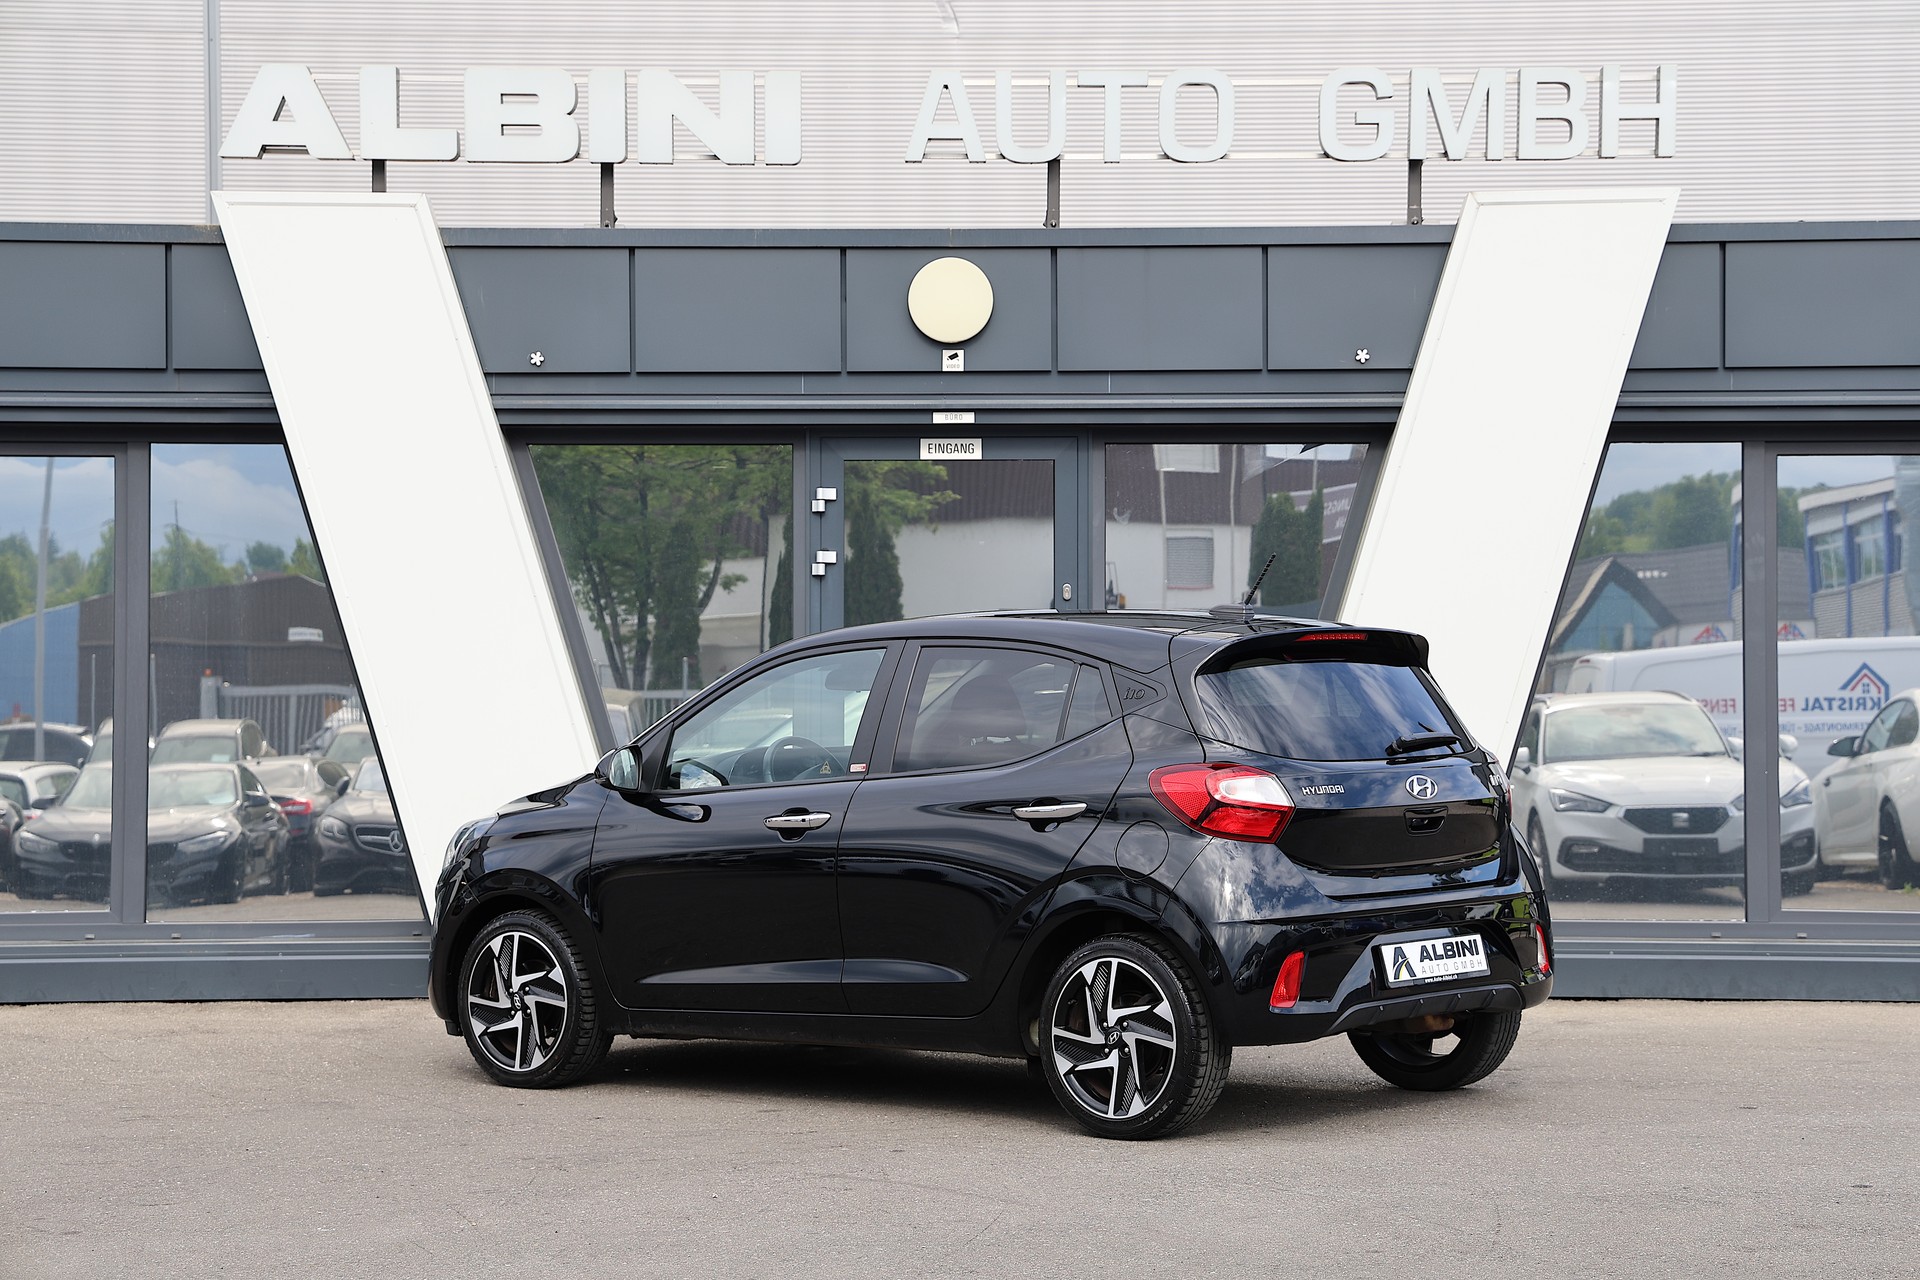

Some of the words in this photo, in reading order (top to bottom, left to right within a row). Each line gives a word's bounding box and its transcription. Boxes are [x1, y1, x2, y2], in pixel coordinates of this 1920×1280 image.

[218, 63, 802, 165] ALBINI
[905, 67, 1236, 163] AUTO
[1318, 65, 1678, 162] GMBH
[944, 413, 963, 421] BÜRO
[927, 442, 975, 454] EINGANG
[1301, 784, 1345, 796] HYUNDAI
[1419, 938, 1480, 962] ALBINI
[1421, 962, 1449, 975] AUTO
[1453, 959, 1483, 971] GMBH
